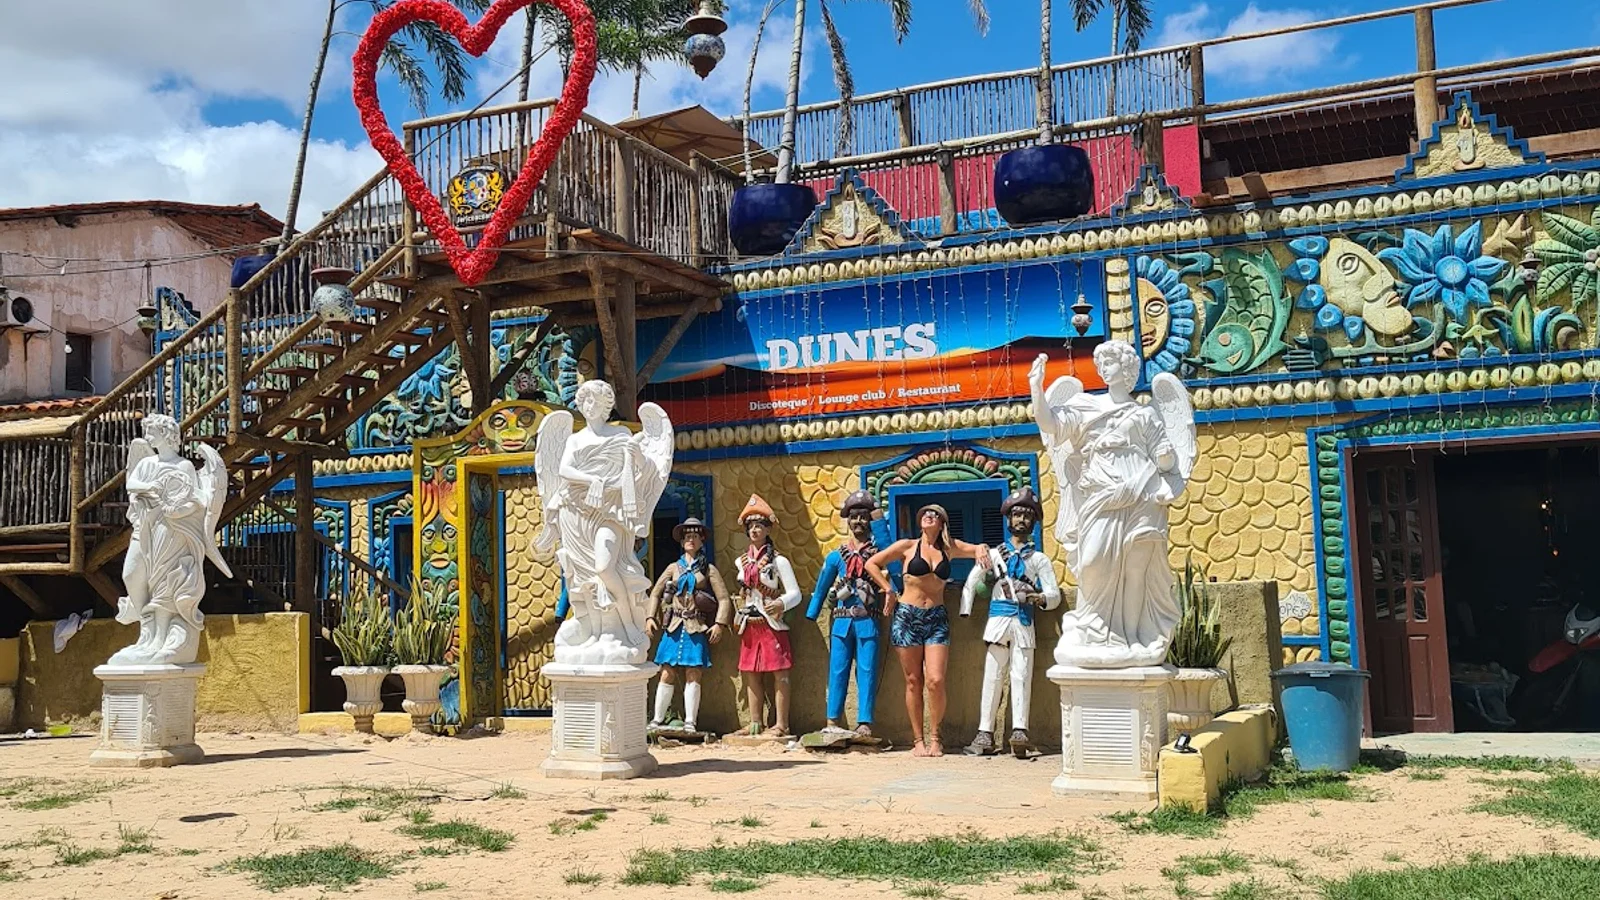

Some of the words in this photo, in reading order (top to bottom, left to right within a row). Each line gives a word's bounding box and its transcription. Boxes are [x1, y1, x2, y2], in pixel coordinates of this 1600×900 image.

[766, 322, 937, 371] DUNES
[749, 398, 807, 411] Discoteque
[818, 393, 859, 404] Lounge
[861, 389, 887, 401] club
[897, 383, 961, 398] Restaurant
